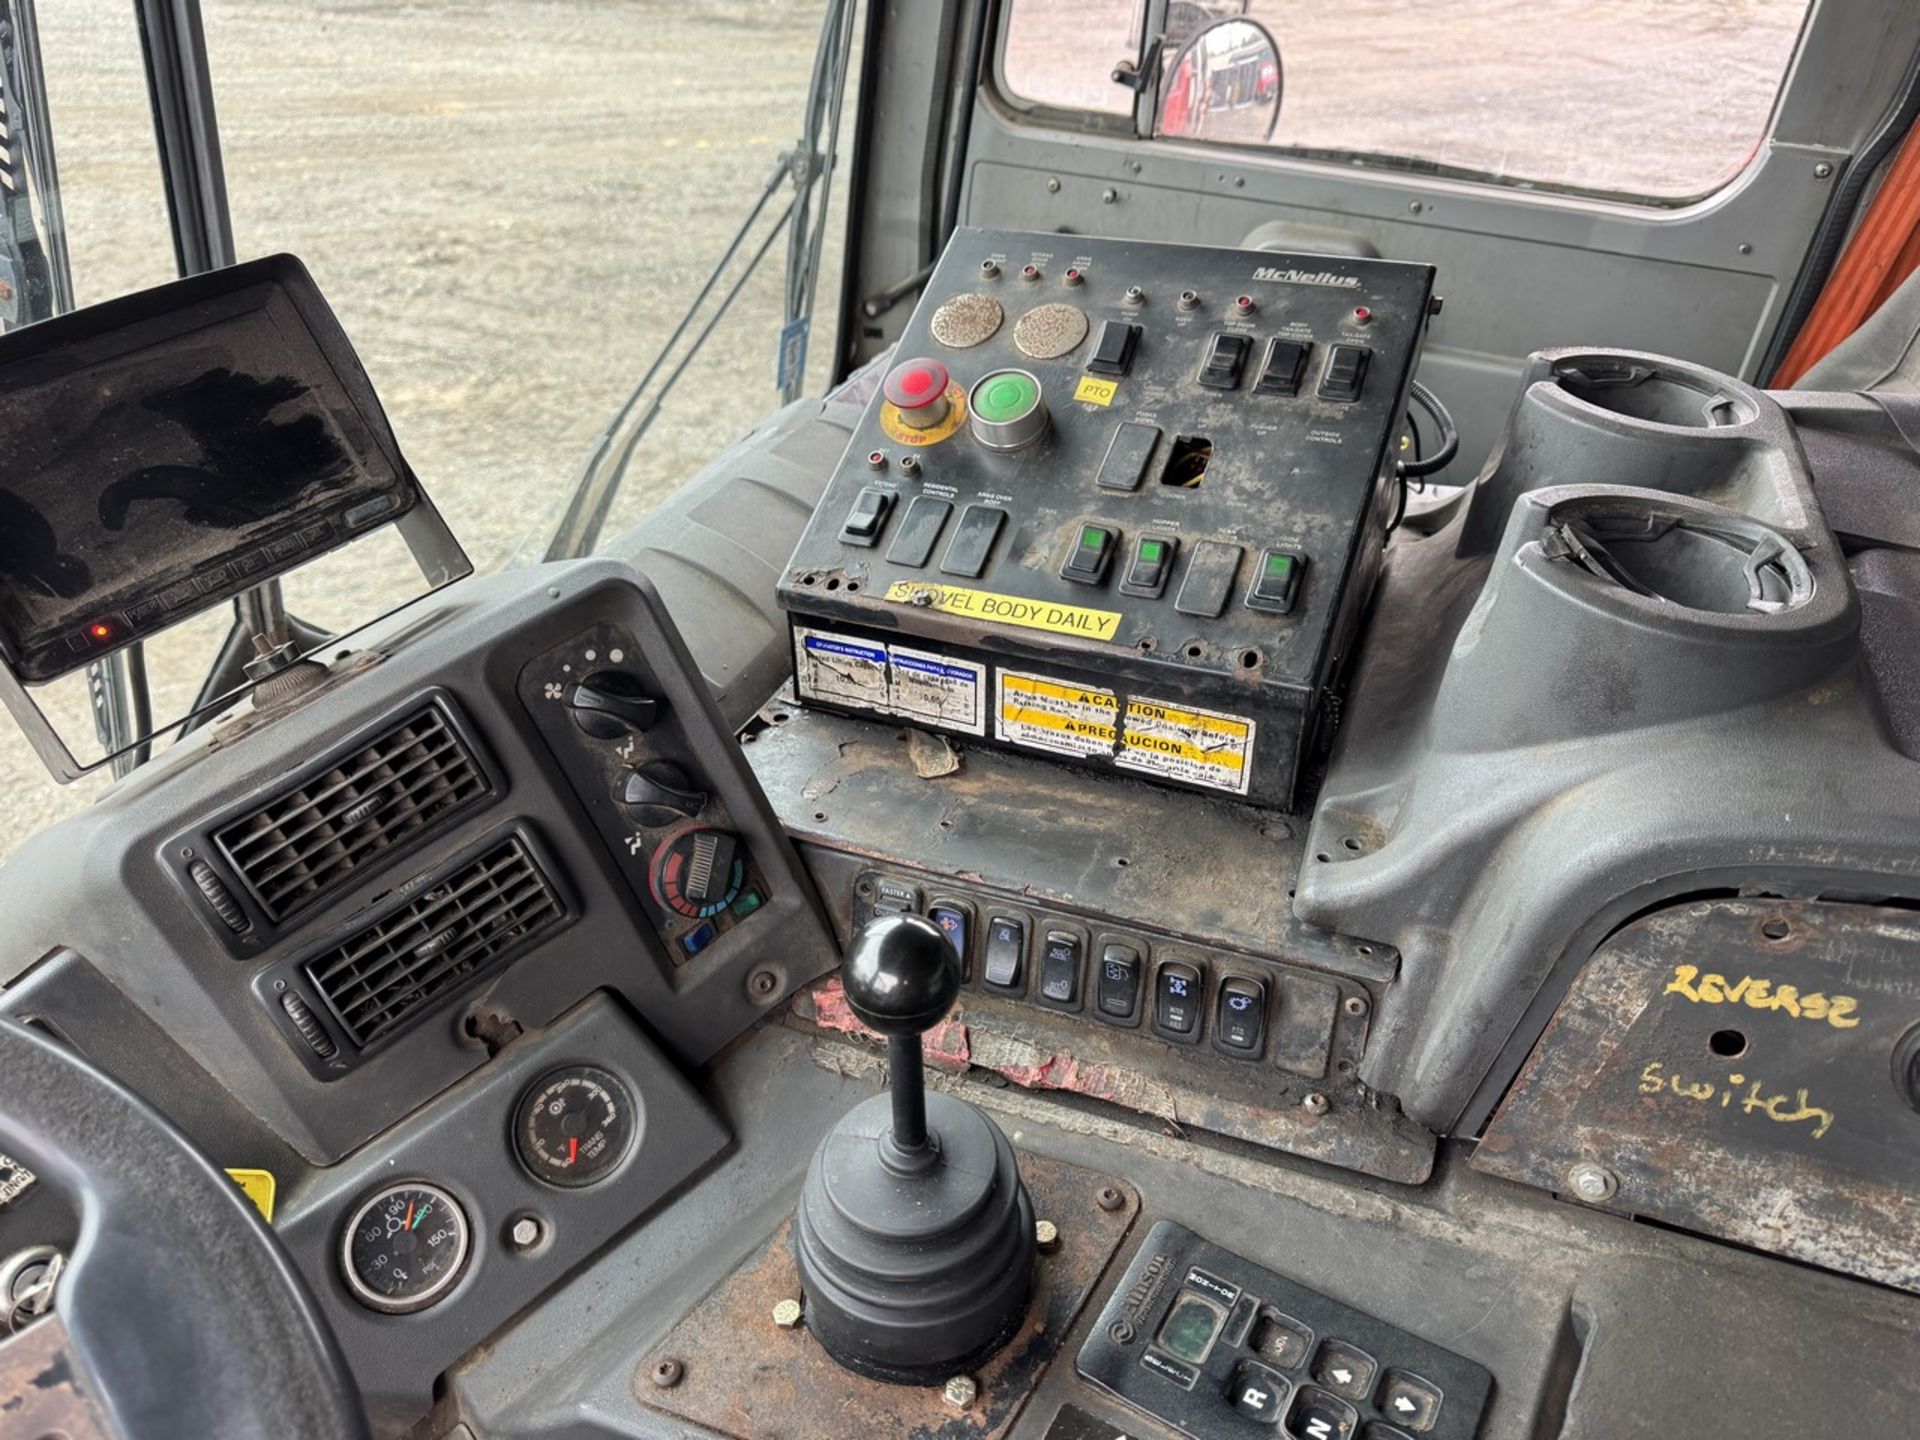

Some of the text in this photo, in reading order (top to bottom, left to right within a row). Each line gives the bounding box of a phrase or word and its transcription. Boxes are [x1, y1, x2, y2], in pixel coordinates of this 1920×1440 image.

[1252, 267, 1362, 288] McNeilus
[1341, 331, 1373, 339] TAILGATE
[1083, 384, 1111, 399] PTO
[897, 432, 927, 444] STOP
[1305, 435, 1343, 445] CONTROLS
[1310, 429, 1341, 438] OUTSIDE
[922, 489, 955, 499] CONTROLS
[1151, 518, 1180, 527] HOPPER
[981, 598, 1043, 621] BODY
[1046, 610, 1111, 632] DAILY
[1067, 701, 1079, 710] be
[1082, 704, 1092, 713] in
[1095, 707, 1111, 716] the
[881, 886, 905, 898] FASTER
[579, 1130, 605, 1154] TRANS
[586, 1138, 607, 1160] TEMP
[388, 1199, 406, 1216] 90
[364, 1226, 382, 1243] 60
[427, 1228, 447, 1247] 150
[371, 1254, 388, 1271] 30
[1124, 1254, 1167, 1316] Allison
[1188, 1272, 1236, 1299] MONITOR
[1242, 1388, 1268, 1409] R
[1306, 1417, 1332, 1440] N
